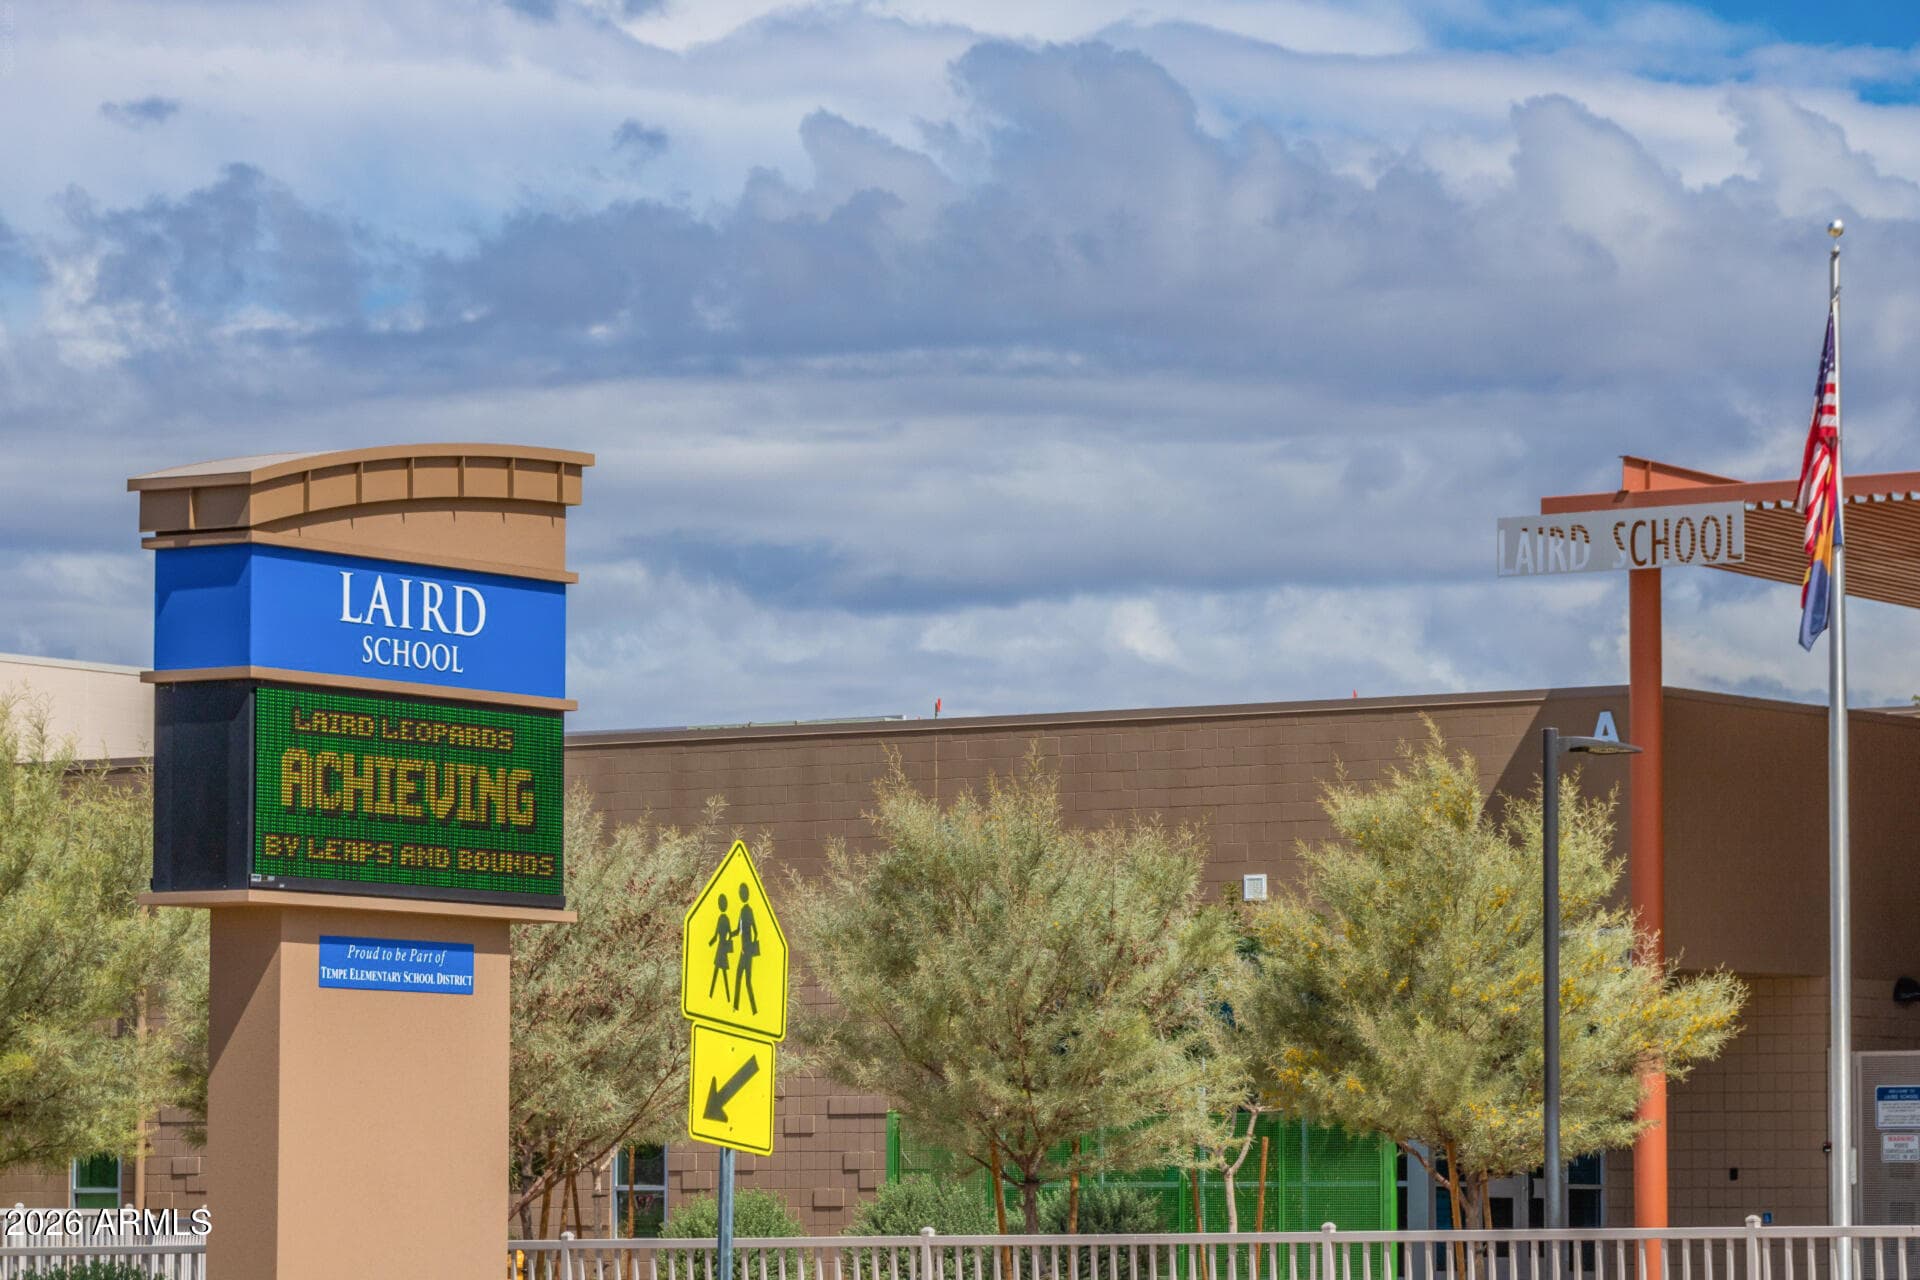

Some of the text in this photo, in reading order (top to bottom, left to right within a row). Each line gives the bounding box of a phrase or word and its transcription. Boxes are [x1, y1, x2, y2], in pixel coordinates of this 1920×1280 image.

[1498, 515, 1742, 576] LAIRD SCHOOL
[340, 571, 486, 637] LAIRD
[362, 635, 463, 673] SCHOOL
[294, 708, 513, 750] LAIRD LEOPARDS
[1594, 711, 1620, 742] A
[281, 748, 535, 826] ACHIEVING
[265, 835, 554, 876] BY LEAPS AND BOUNDS
[347, 944, 448, 967] Proud to be Part of
[320, 966, 473, 987] TEMPE ELEMENTARY SCHOOL DISTRICT
